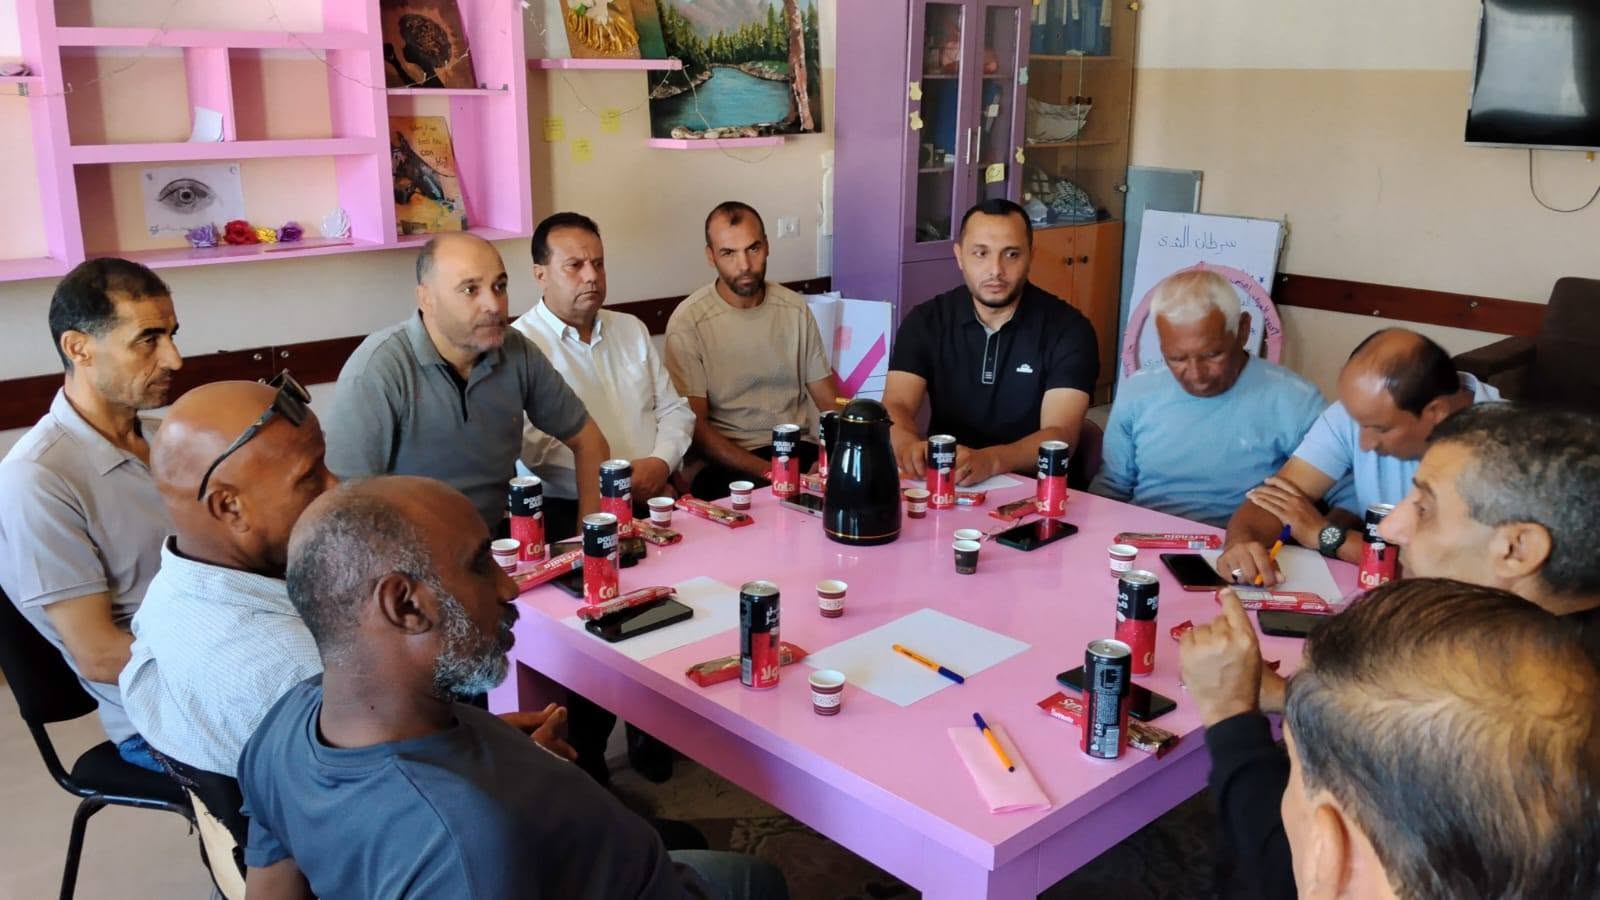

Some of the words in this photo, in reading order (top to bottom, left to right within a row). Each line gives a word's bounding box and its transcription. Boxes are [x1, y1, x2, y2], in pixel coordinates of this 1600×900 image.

[1195, 231, 1238, 253] سرطان
[617, 521, 633, 535] Col
[527, 540, 544, 555] Col
[599, 583, 617, 599] Col
